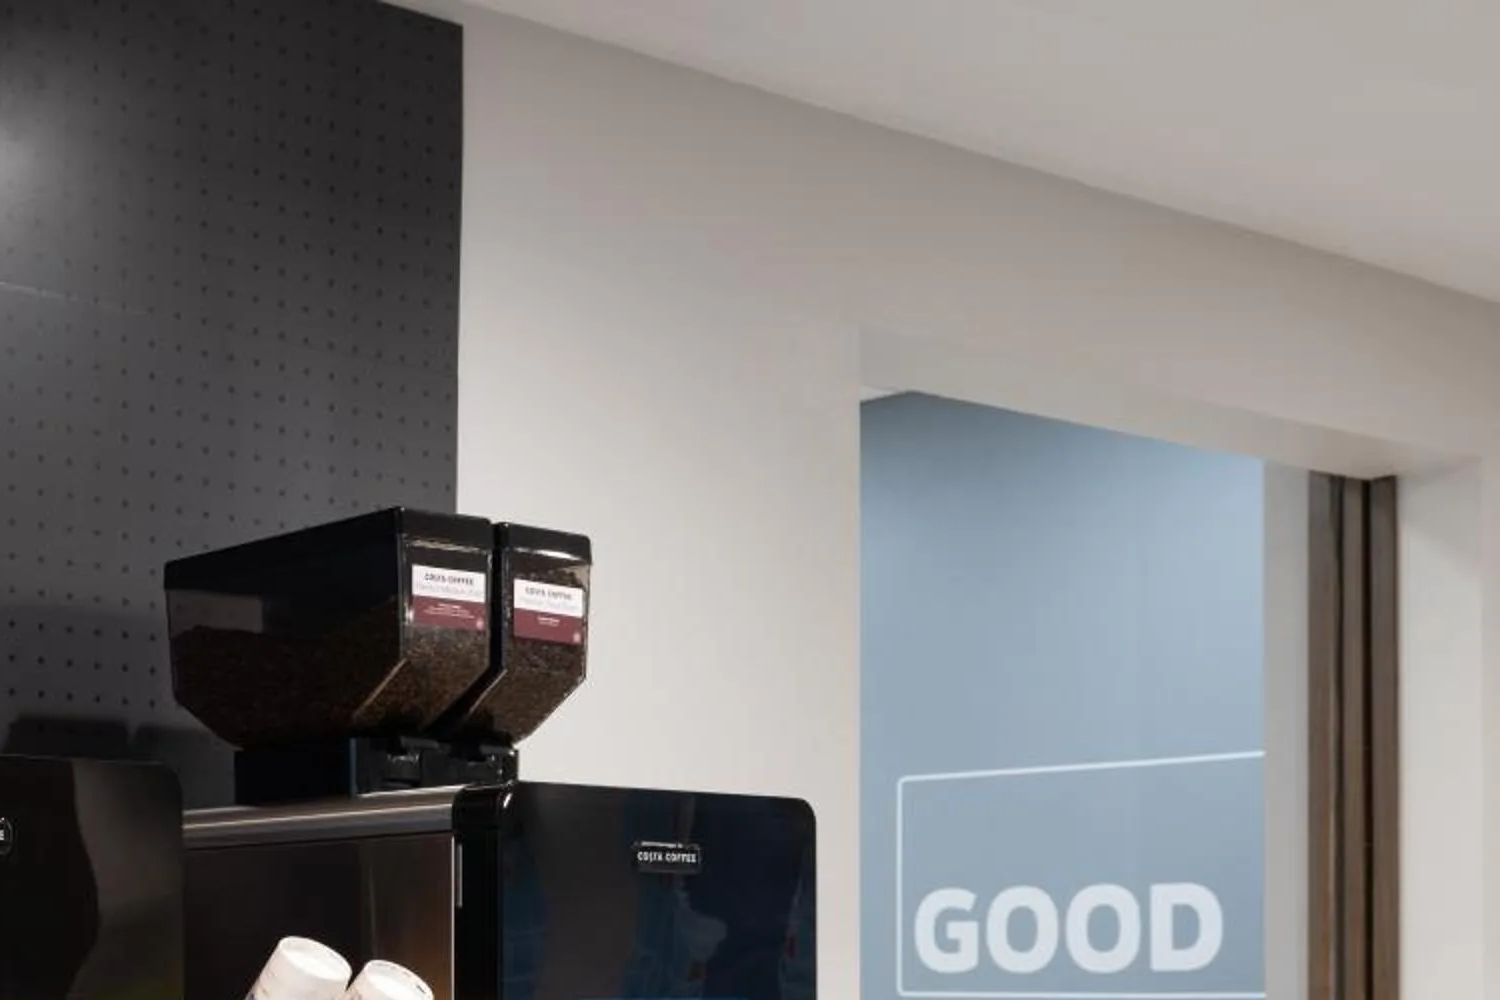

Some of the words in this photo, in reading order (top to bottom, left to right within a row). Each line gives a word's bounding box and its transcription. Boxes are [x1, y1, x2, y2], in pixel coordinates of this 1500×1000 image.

[637, 851, 663, 863] COSTA
[665, 852, 697, 863] COFFEE
[913, 882, 1224, 974] GOOD
